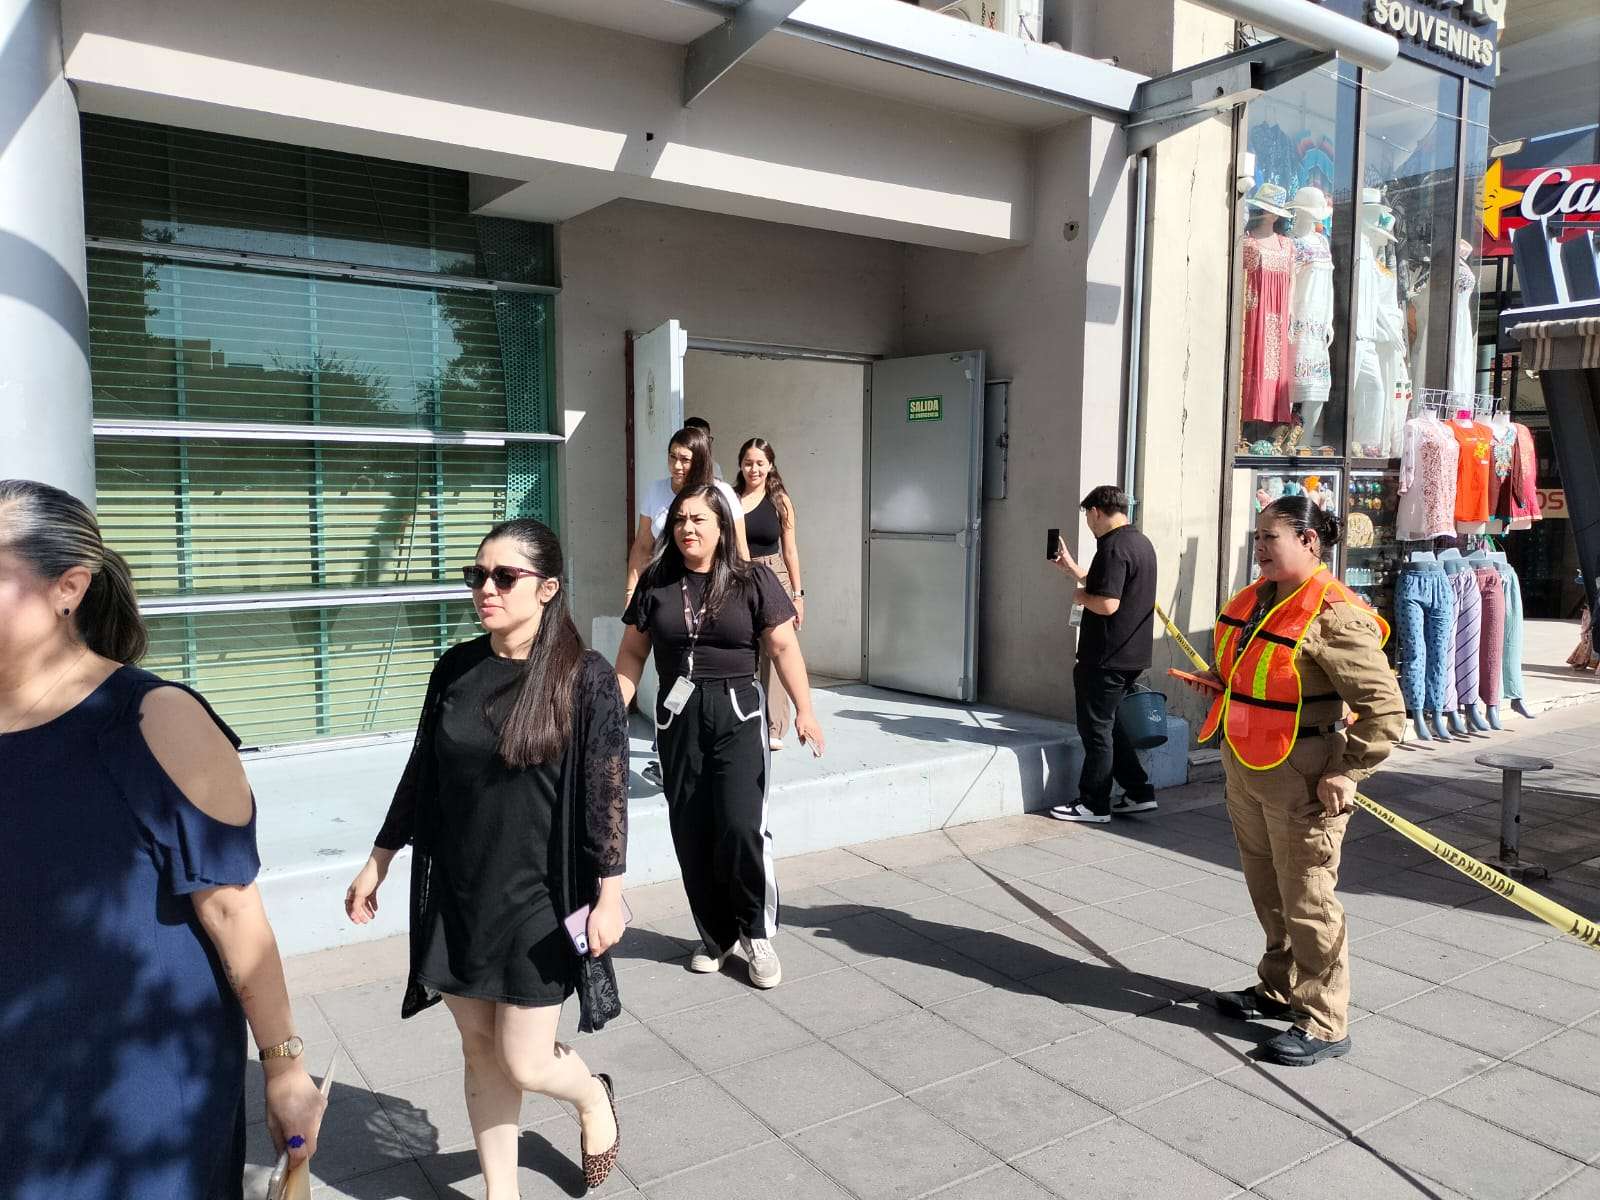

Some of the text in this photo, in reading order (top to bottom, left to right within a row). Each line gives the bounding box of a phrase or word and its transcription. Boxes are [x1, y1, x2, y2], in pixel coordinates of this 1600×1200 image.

[1374, 0, 1494, 67] SOUVENIRS
[1521, 168, 1600, 221] Ca
[910, 400, 939, 412] SALIDA
